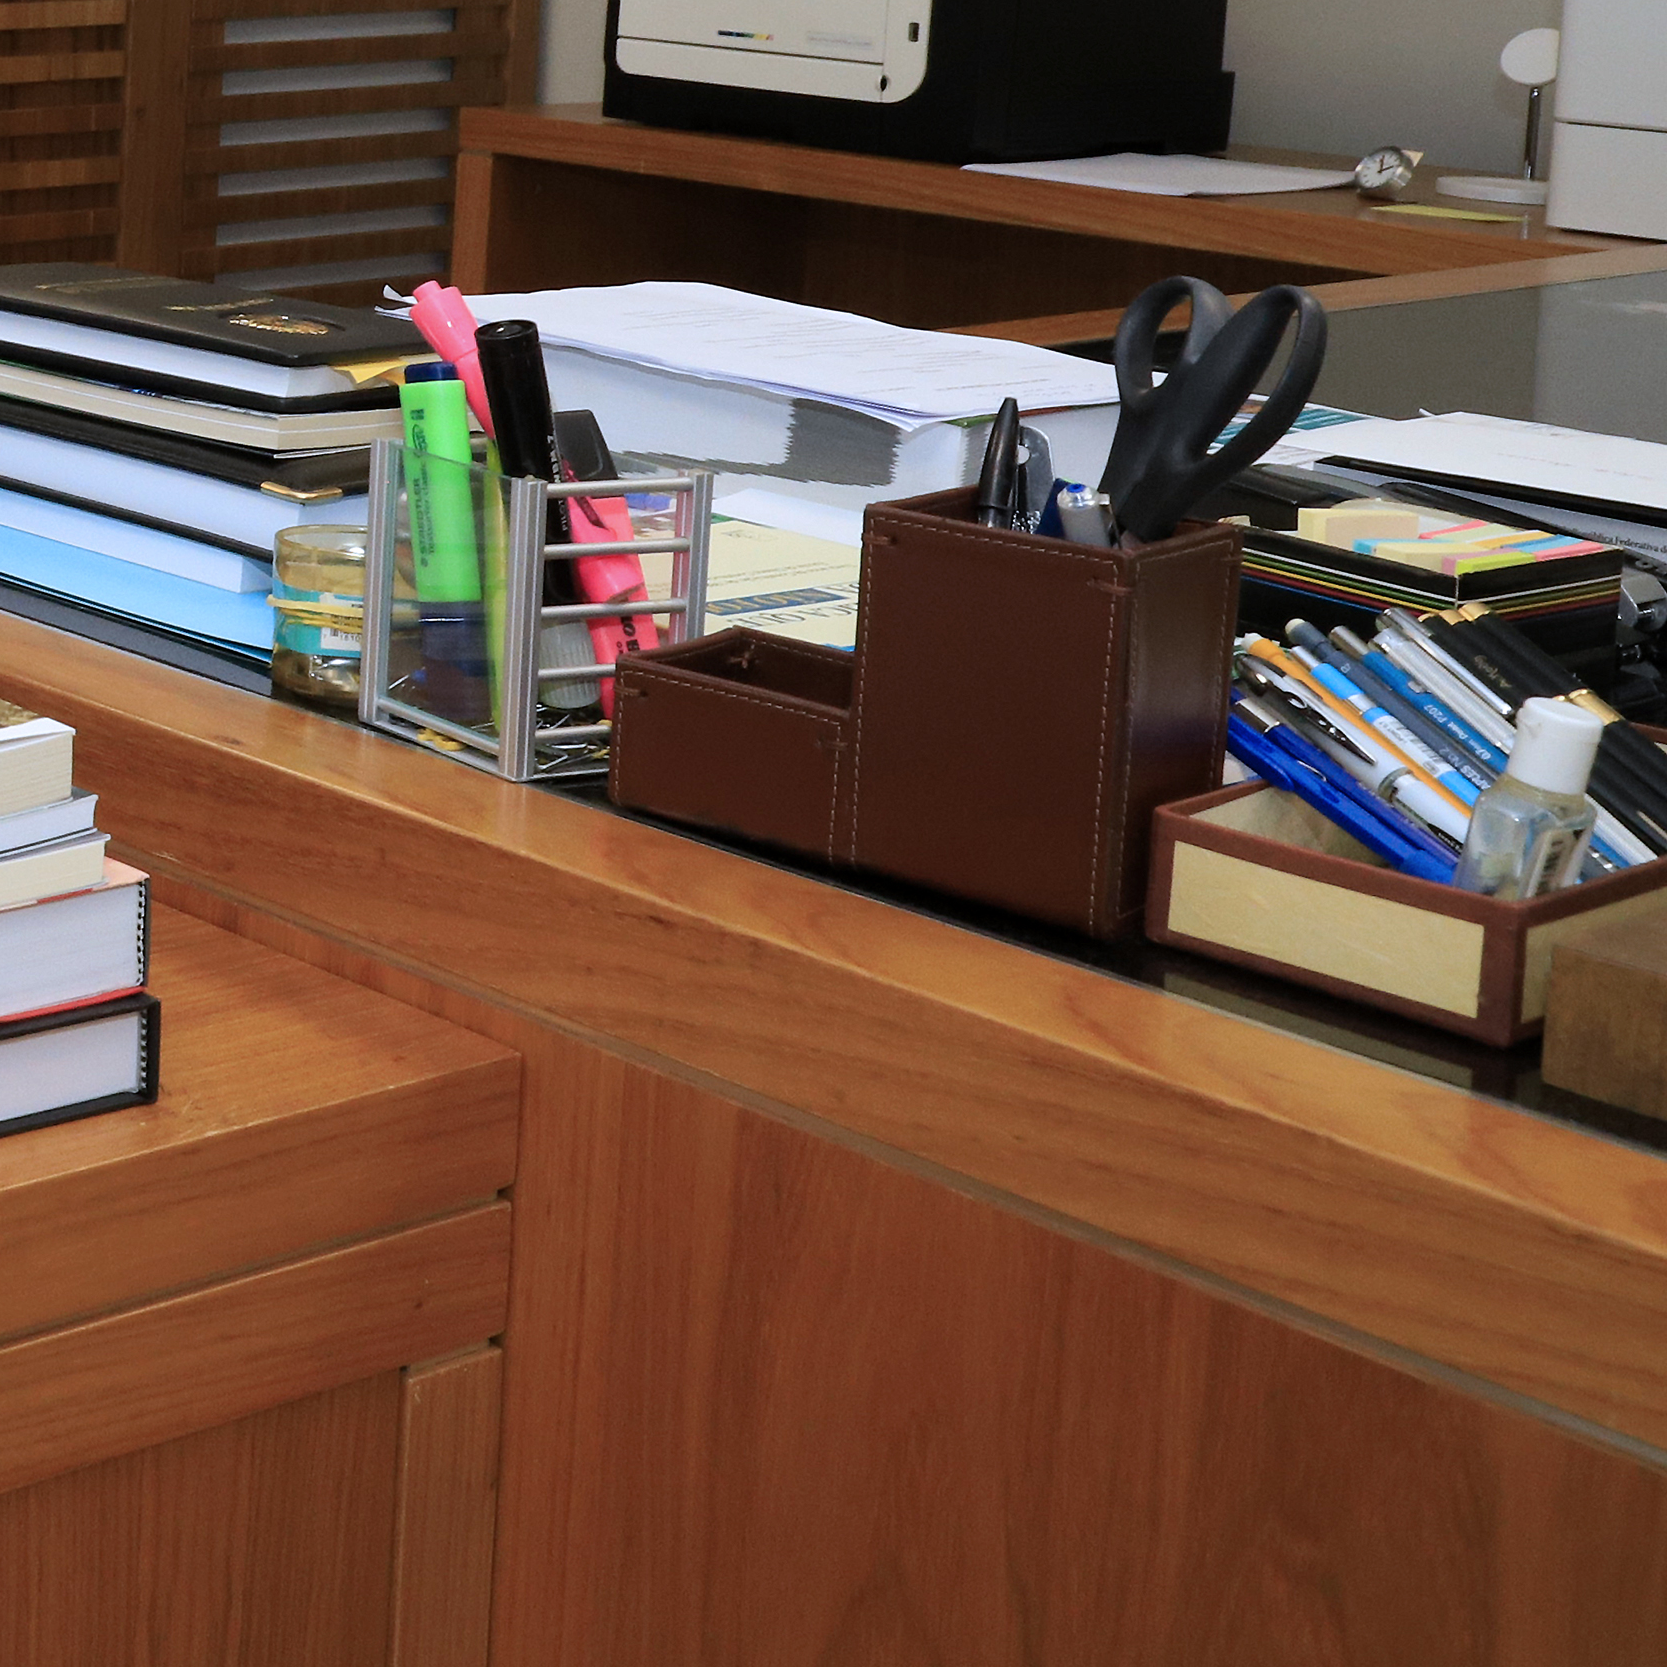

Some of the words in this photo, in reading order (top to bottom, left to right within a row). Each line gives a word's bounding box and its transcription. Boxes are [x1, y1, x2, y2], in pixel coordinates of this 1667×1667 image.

[1615, 536, 1659, 553] Federativa
[1423, 703, 1451, 730] P207
[1447, 720, 1469, 742] Pentel
